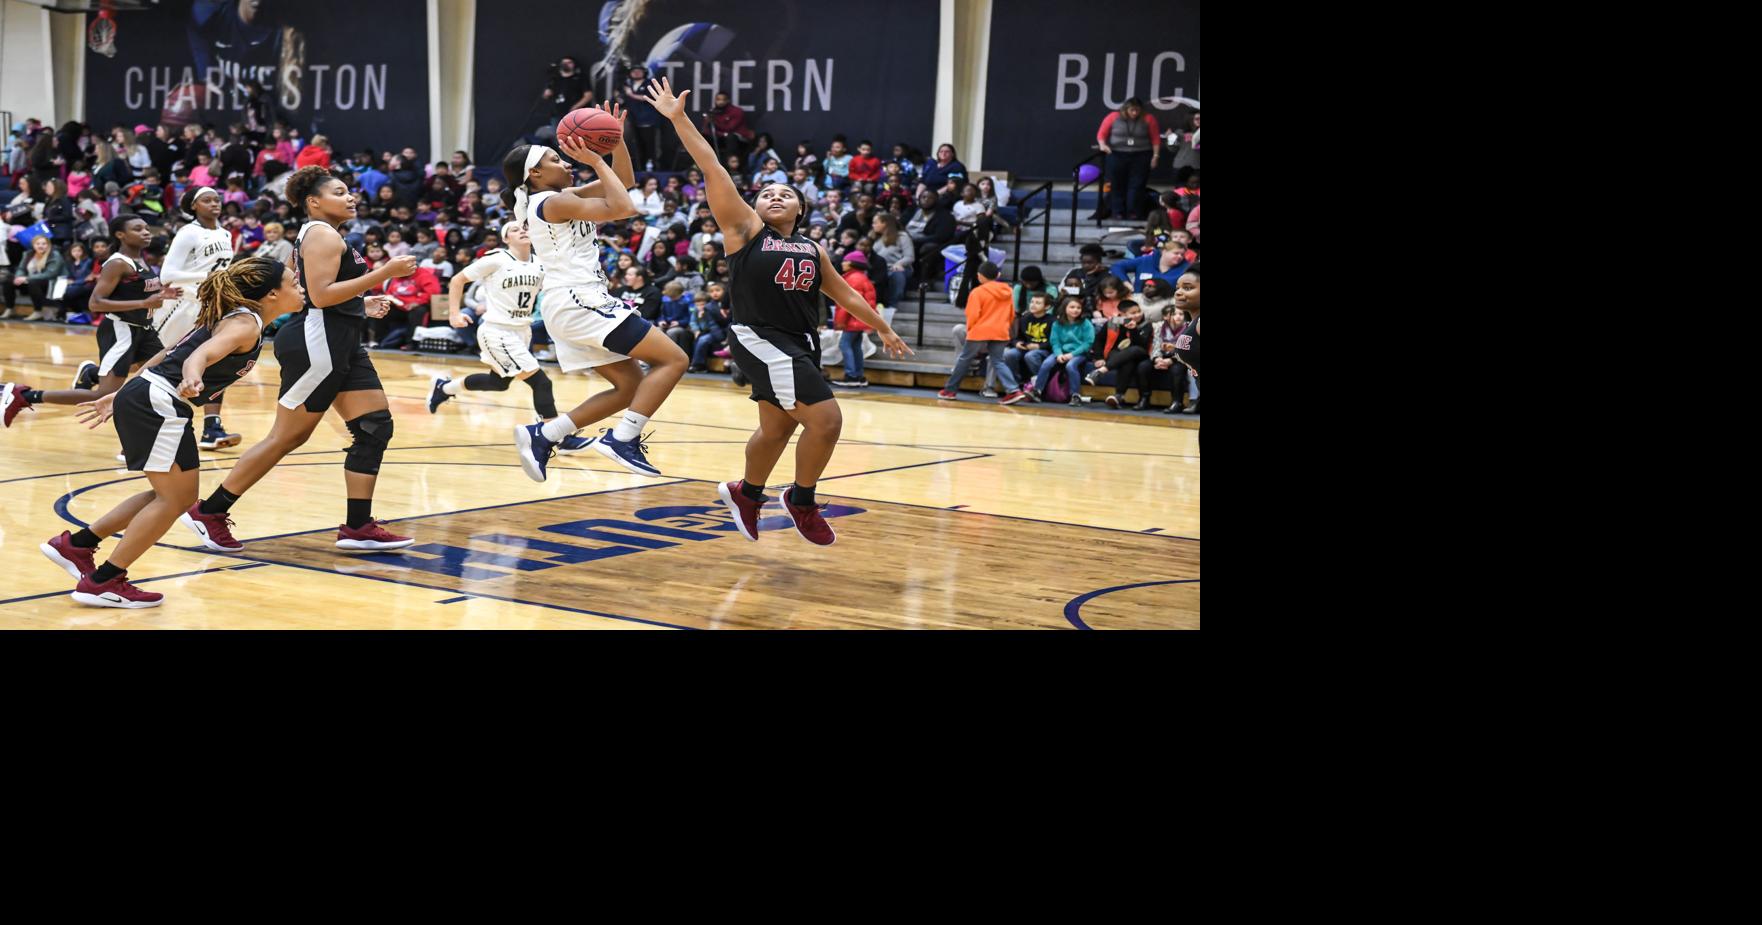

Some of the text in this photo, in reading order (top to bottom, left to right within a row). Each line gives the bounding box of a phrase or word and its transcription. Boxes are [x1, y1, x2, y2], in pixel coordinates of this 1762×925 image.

[1054, 51, 1200, 110] BUC
[774, 257, 816, 291] 42
[517, 291, 531, 309] 12
